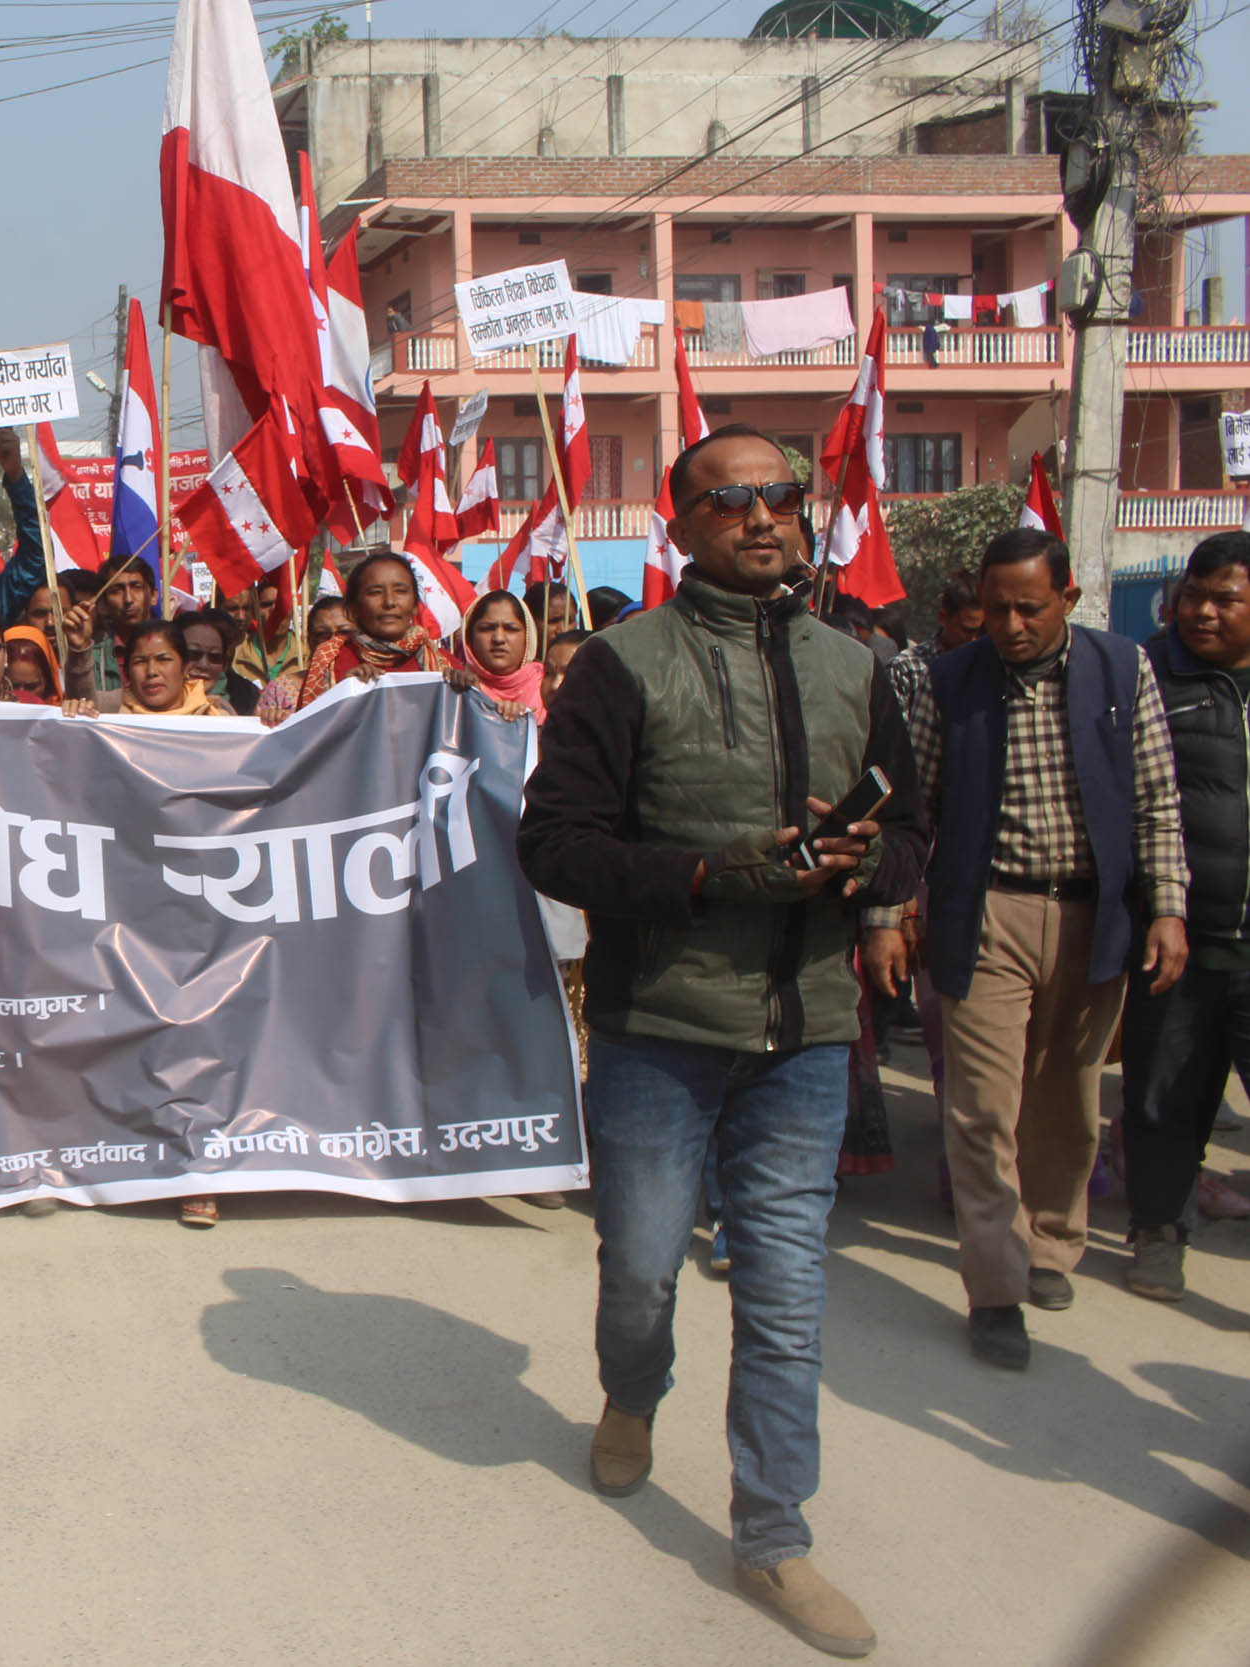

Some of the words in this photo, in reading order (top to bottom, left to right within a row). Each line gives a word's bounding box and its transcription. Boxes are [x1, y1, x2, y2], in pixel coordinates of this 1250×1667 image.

[25, 353, 67, 380] मर्यादा
[30, 393, 52, 414] गर
[203, 1125, 309, 1159] नेपाली
[438, 1112, 561, 1152] उदयपुर
[58, 1140, 148, 1169] मुर्दावाद
